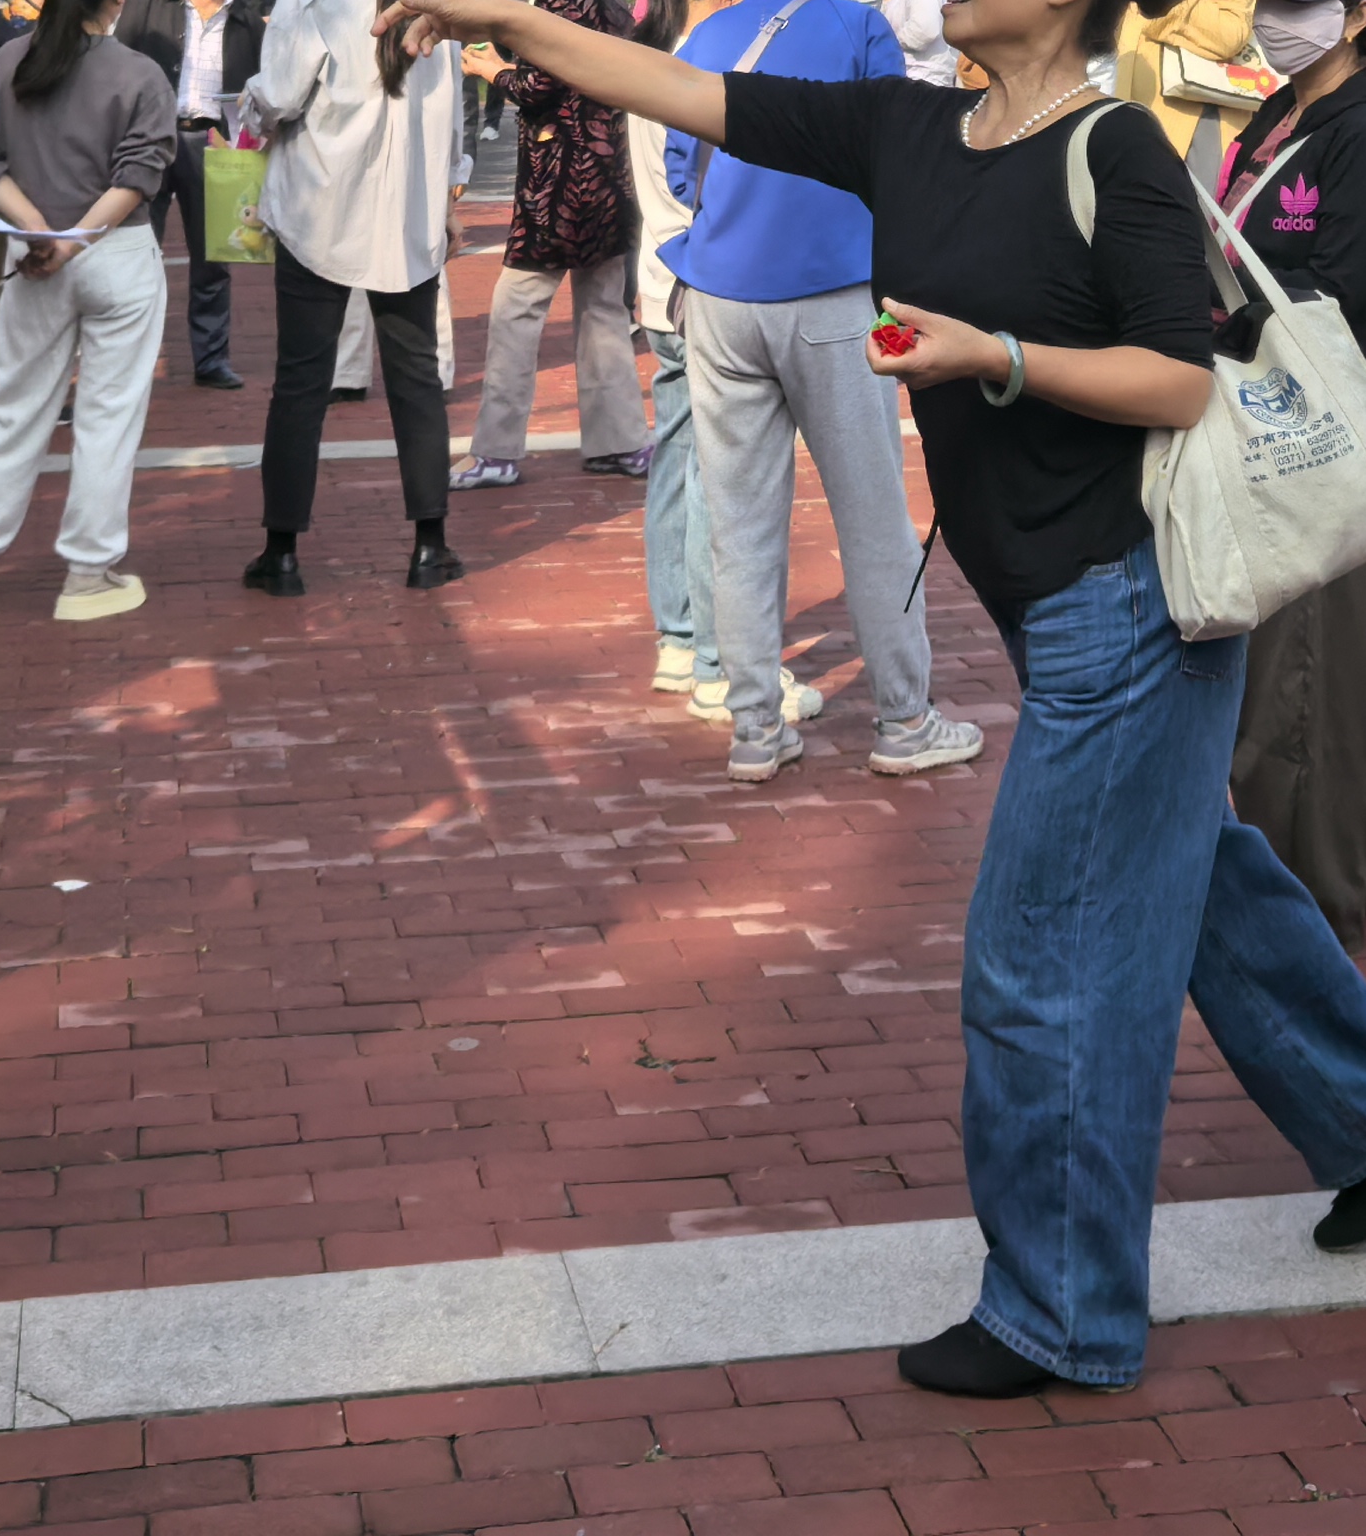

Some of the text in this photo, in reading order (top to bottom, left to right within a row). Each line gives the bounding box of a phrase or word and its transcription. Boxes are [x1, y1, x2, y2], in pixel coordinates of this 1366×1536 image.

[1272, 216, 1317, 232] adida
[1246, 411, 1334, 449] 河南有限公司
